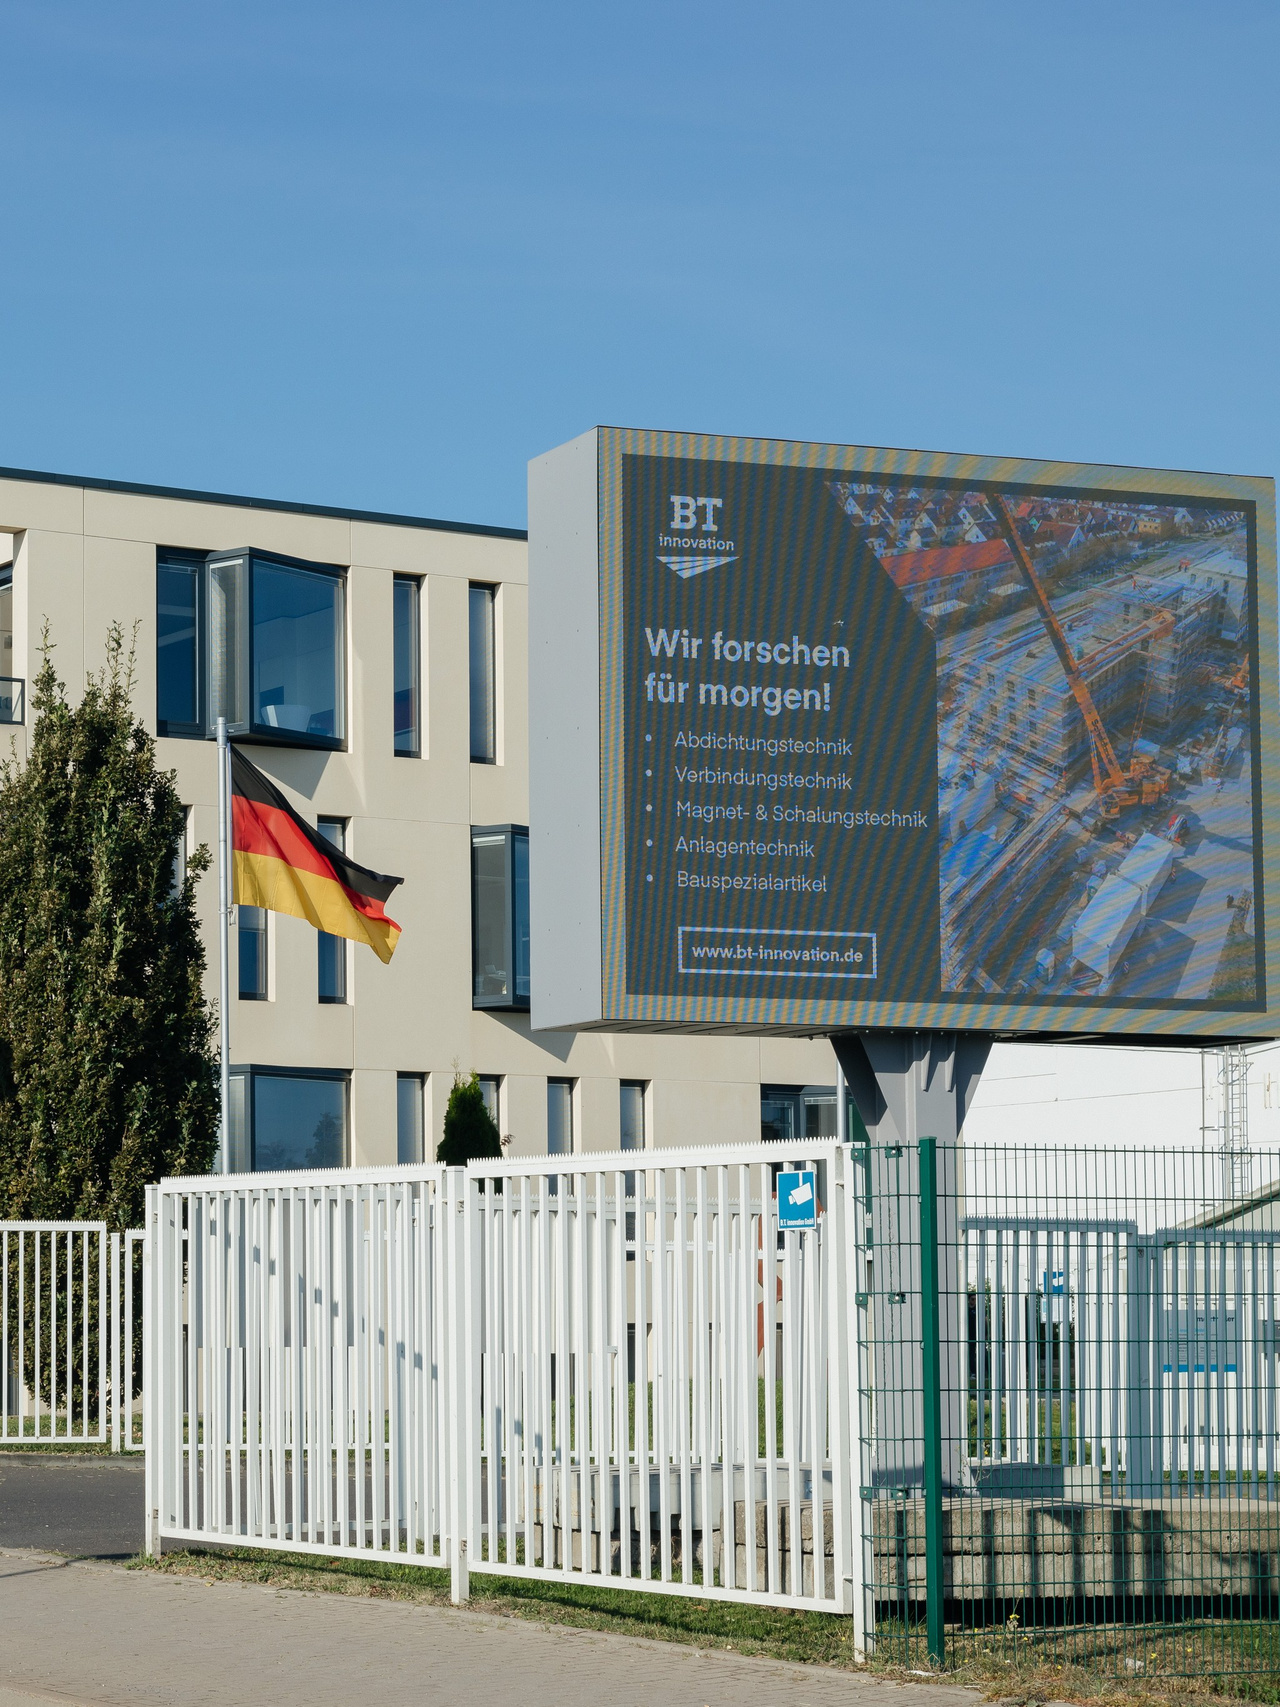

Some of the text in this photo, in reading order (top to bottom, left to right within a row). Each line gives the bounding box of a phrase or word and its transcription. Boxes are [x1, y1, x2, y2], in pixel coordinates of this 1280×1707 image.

[670, 495, 723, 531] BT
[658, 533, 734, 551] innovation
[644, 627, 851, 667] Wir forschen
[644, 672, 831, 716] für morgen!
[674, 731, 853, 756] Abdichtungstechnik
[674, 766, 852, 791] Verbindungstechnik
[676, 801, 928, 829] Magnet- & Schalungstechnik
[675, 836, 815, 858] Anlagentechnik
[677, 870, 827, 893] Bauspezialartikel
[692, 945, 863, 963] www.bt-innovation.de
